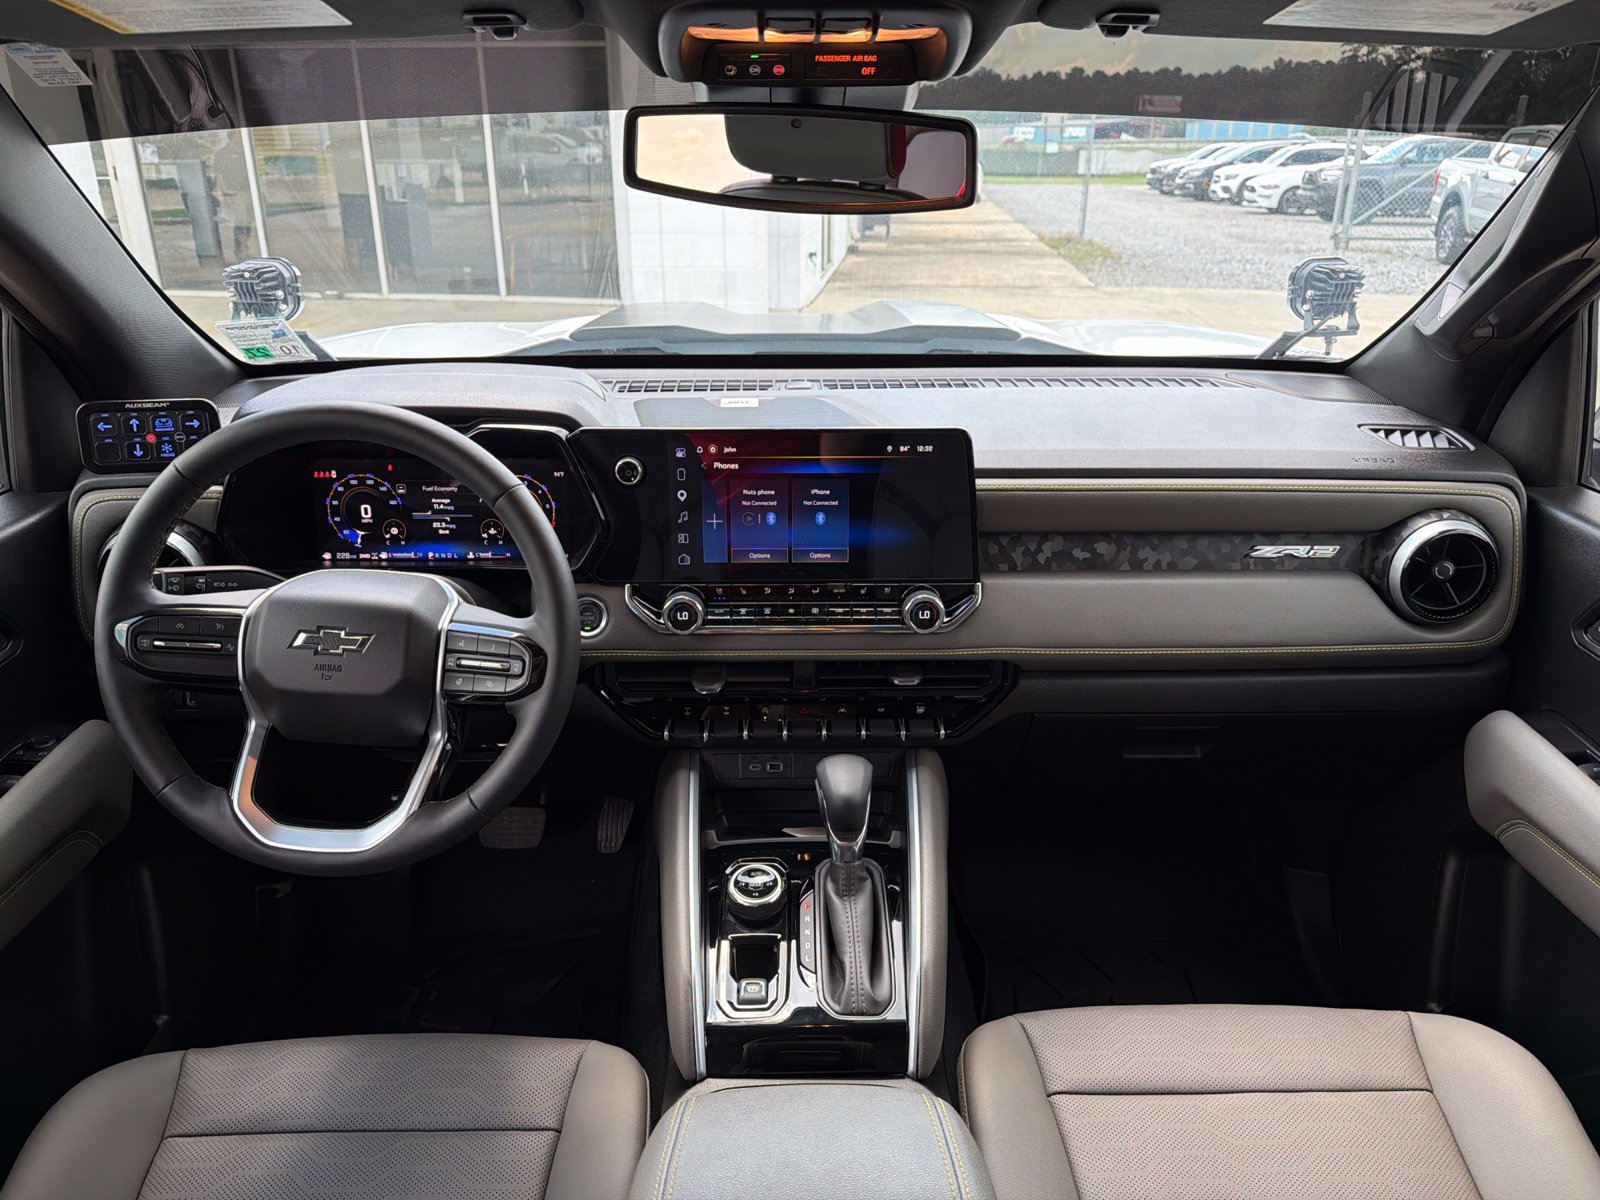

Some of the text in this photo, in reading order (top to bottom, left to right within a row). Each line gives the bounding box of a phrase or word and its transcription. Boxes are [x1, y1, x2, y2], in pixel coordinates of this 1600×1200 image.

[861, 67, 876, 75] OFF
[713, 462, 739, 470] Phones
[360, 504, 372, 518] 0
[1248, 544, 1341, 559] ZR2
[748, 552, 771, 560] Options
[809, 552, 831, 560] Options
[314, 663, 343, 673] AIRBAG
